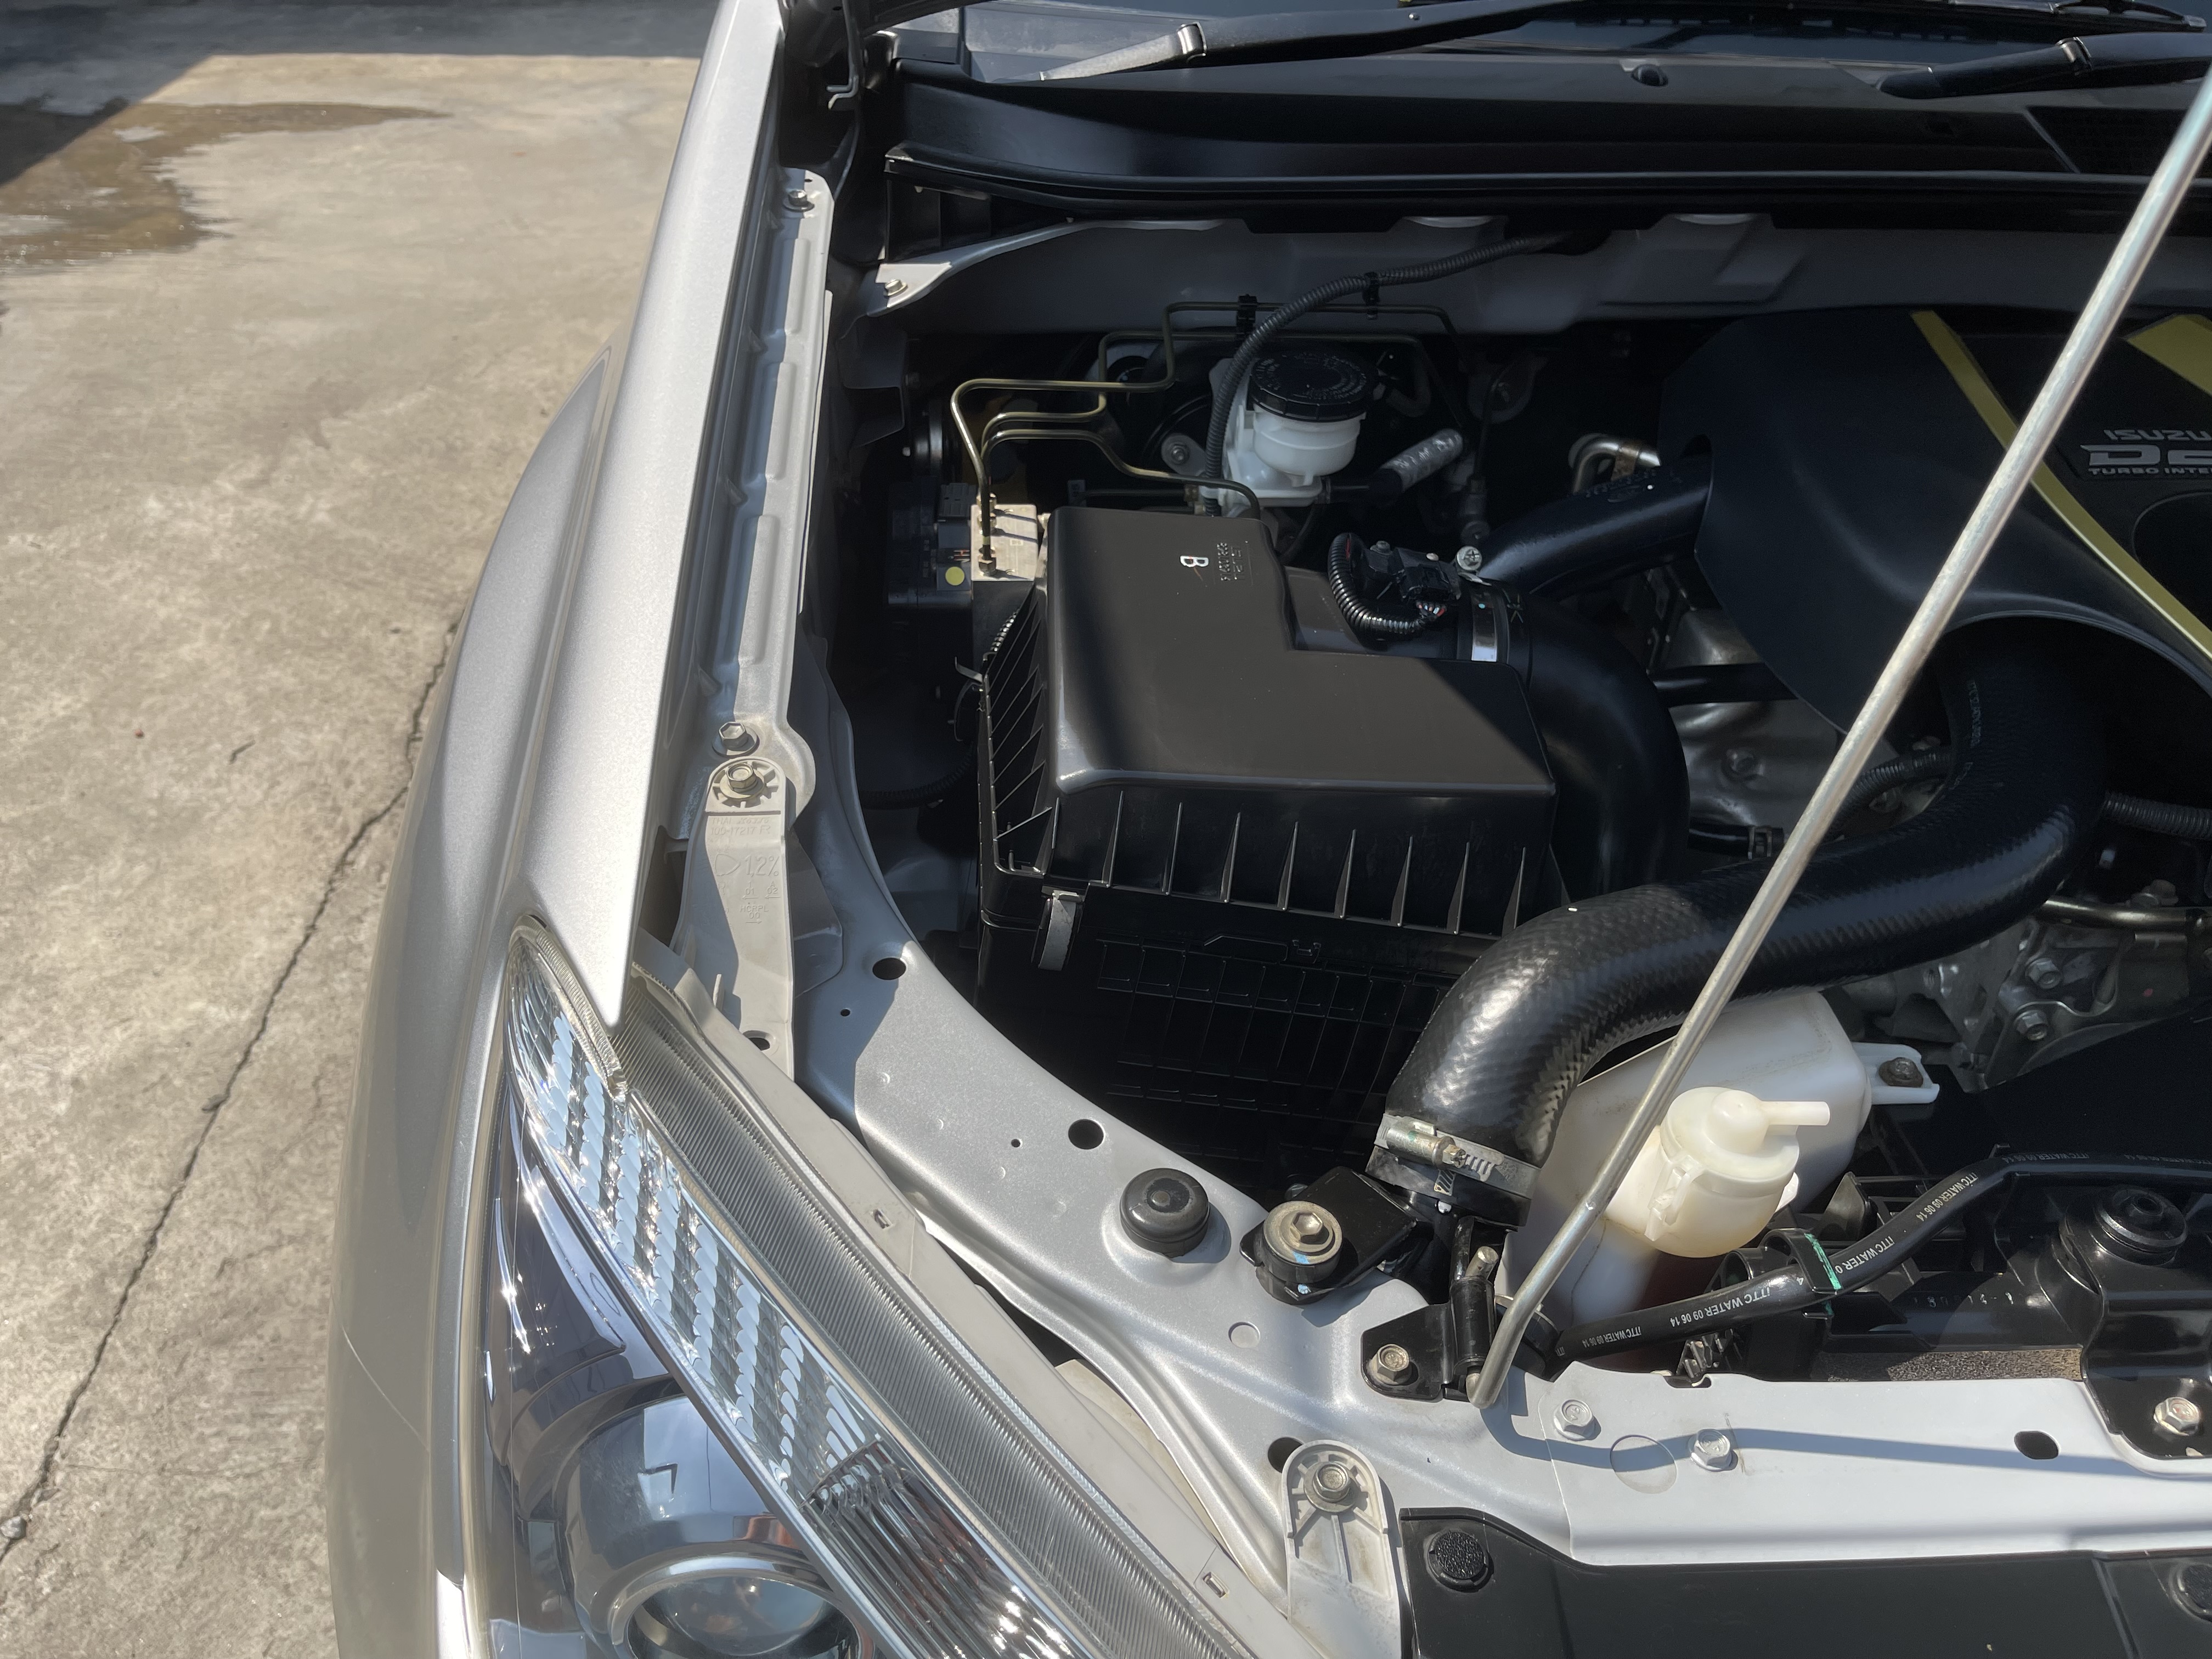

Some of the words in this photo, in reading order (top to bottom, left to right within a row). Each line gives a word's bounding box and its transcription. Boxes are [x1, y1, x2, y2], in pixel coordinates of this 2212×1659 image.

[2103, 429, 2212, 441] ISUZU
[1180, 555, 1209, 568] B
[759, 825, 771, 834] R
[1938, 1182, 1966, 1202] WATER
[1932, 1198, 1944, 1209] 09
[1923, 1205, 1936, 1215] 06
[1916, 1211, 1928, 1222] 14
[1842, 1248, 1878, 1270] WATER
[1704, 1297, 1743, 1317] WATER
[1681, 1313, 1692, 1324] 06
[1693, 1310, 1704, 1321] 09
[1669, 1317, 1680, 1327] 14
[1589, 1337, 1597, 1346] 06
[1596, 1335, 1604, 1344] 09
[1603, 1330, 1627, 1343] WATER
[1582, 1339, 1590, 1348] 14
